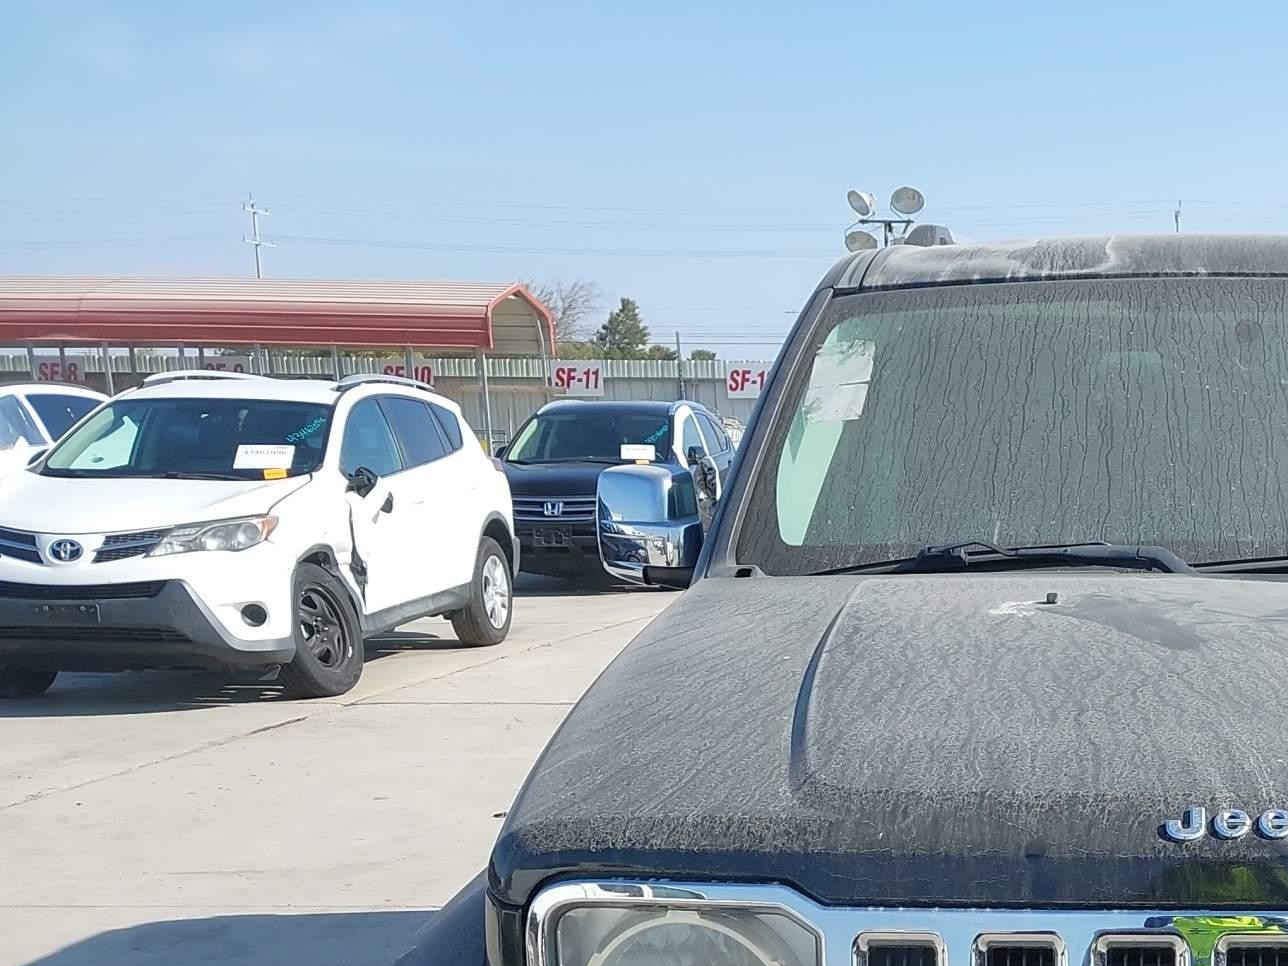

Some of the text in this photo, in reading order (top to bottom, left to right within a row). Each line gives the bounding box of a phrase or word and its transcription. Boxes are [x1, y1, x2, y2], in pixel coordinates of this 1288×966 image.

[37, 362, 79, 383] SF8
[383, 365, 432, 385] SF10
[555, 367, 600, 389] SF-11
[728, 369, 769, 392] SF-1
